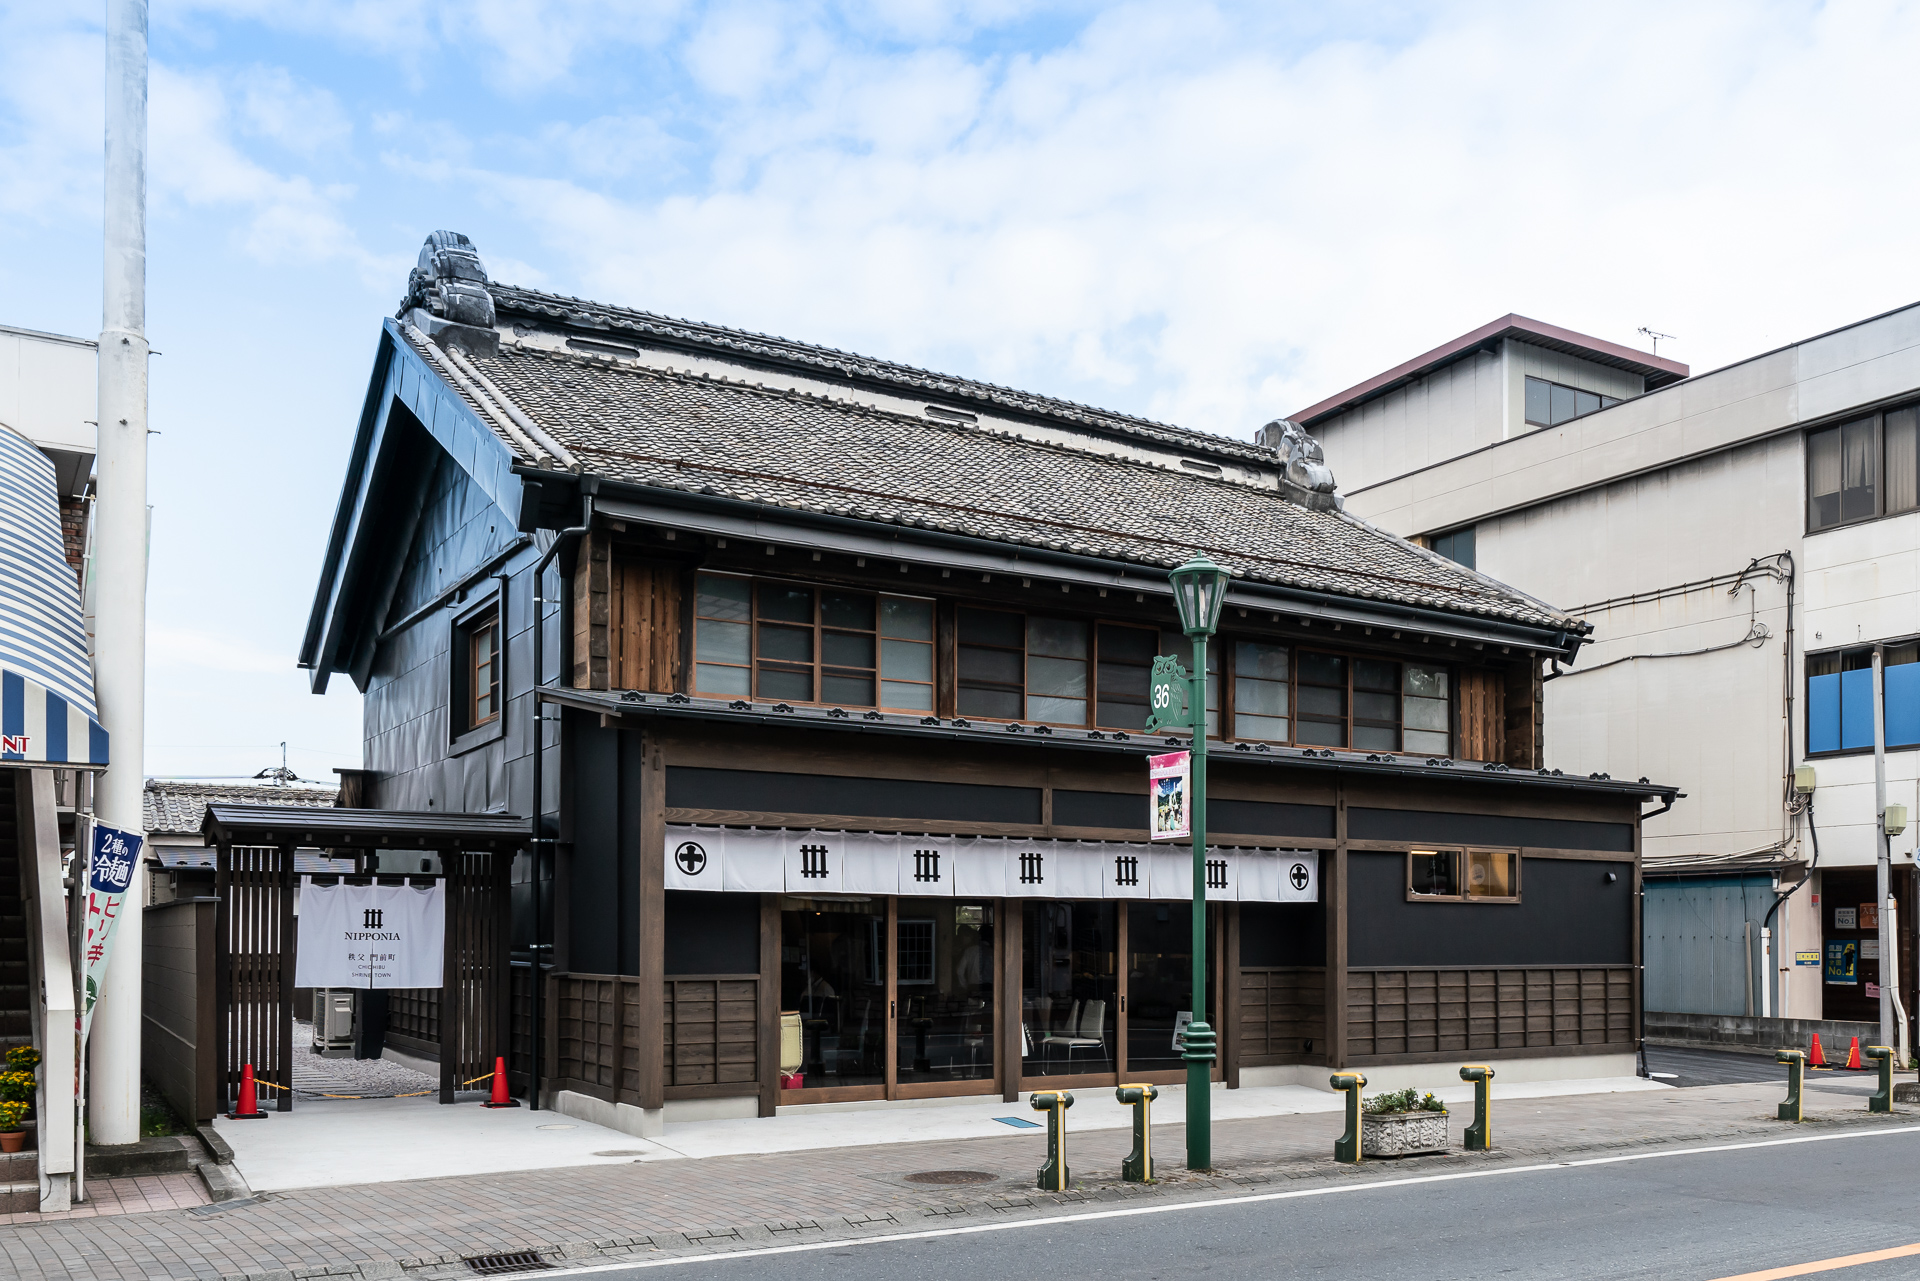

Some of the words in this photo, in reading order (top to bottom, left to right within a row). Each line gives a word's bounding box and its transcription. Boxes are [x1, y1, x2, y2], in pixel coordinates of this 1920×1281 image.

[1153, 683, 1170, 709] 36
[101, 834, 128, 856] 2種の
[92, 854, 131, 887] 冷麺
[344, 932, 400, 940] NIPPONIA
[348, 953, 365, 961] 秩父
[370, 953, 396, 961] 門前町
